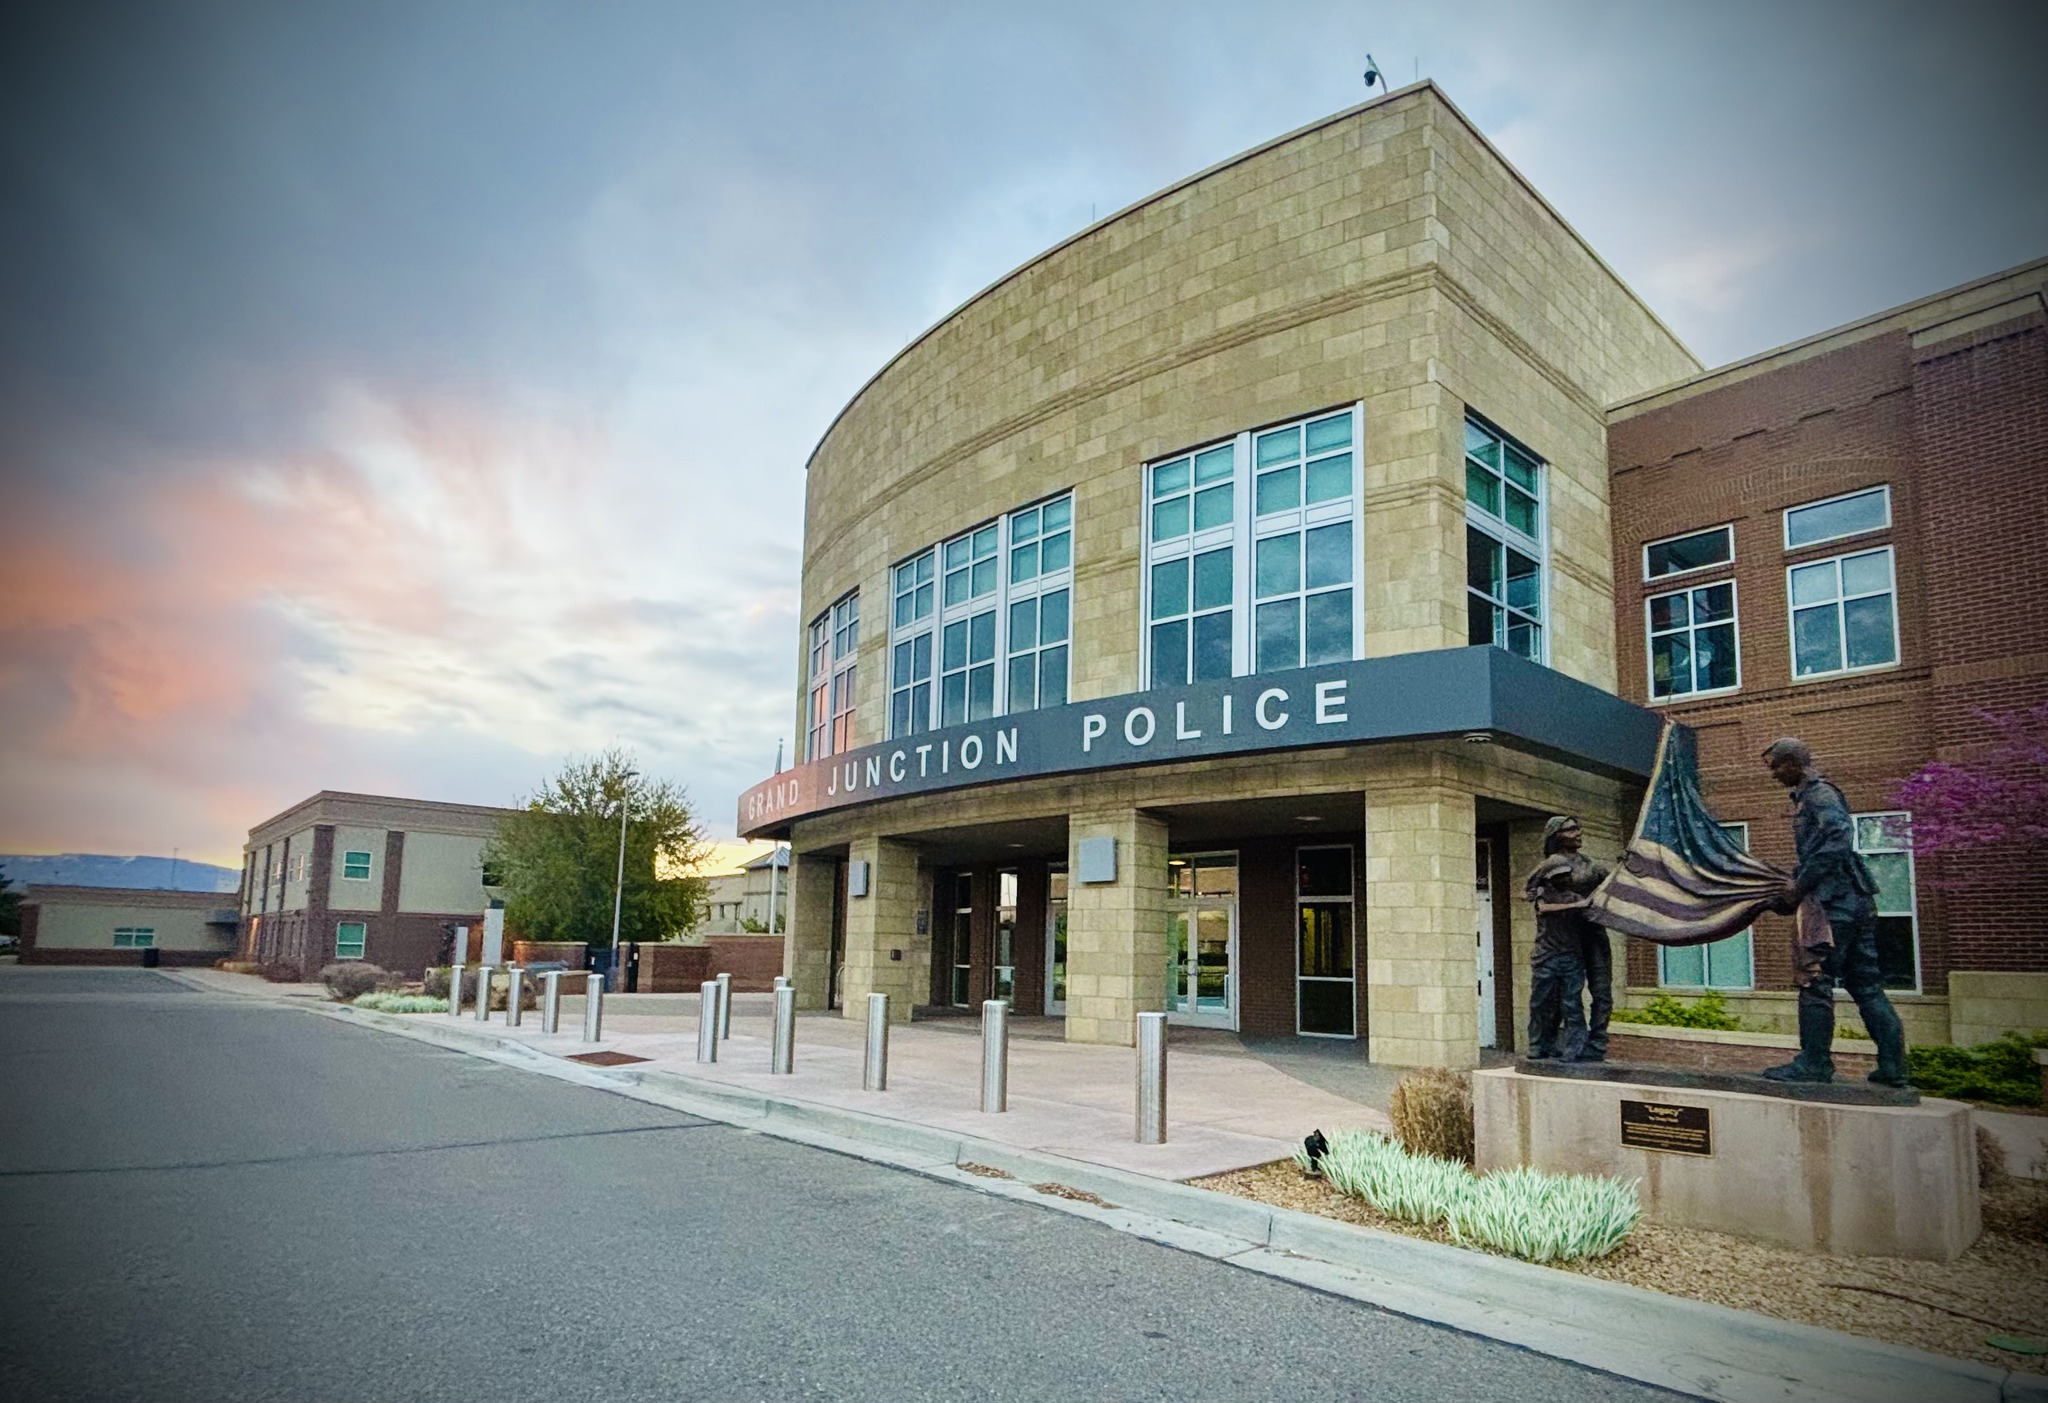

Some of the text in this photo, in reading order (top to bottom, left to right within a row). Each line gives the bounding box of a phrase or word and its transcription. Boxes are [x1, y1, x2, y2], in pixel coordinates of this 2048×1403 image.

[749, 680, 1348, 821] GRAND JUNCTION POLICE
